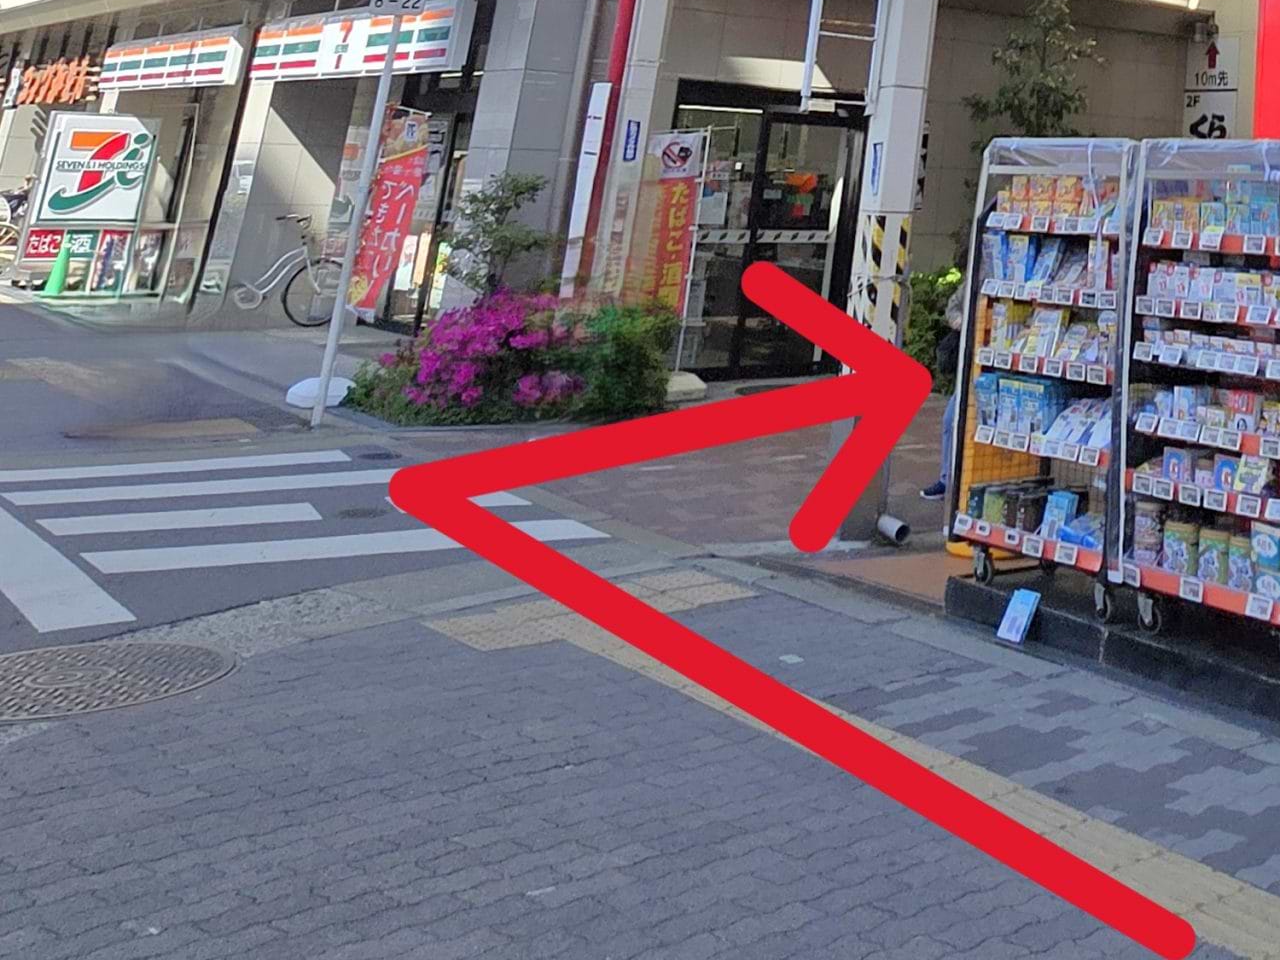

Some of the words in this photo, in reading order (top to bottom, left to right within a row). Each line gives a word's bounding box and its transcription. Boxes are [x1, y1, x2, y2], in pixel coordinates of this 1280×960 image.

[1195, 70, 1228, 87] 10m先
[1186, 95, 1200, 108] 2F
[56, 160, 85, 170] SEVEN
[98, 161, 145, 171] HOLDINGS
[26, 234, 62, 254] たばこ
